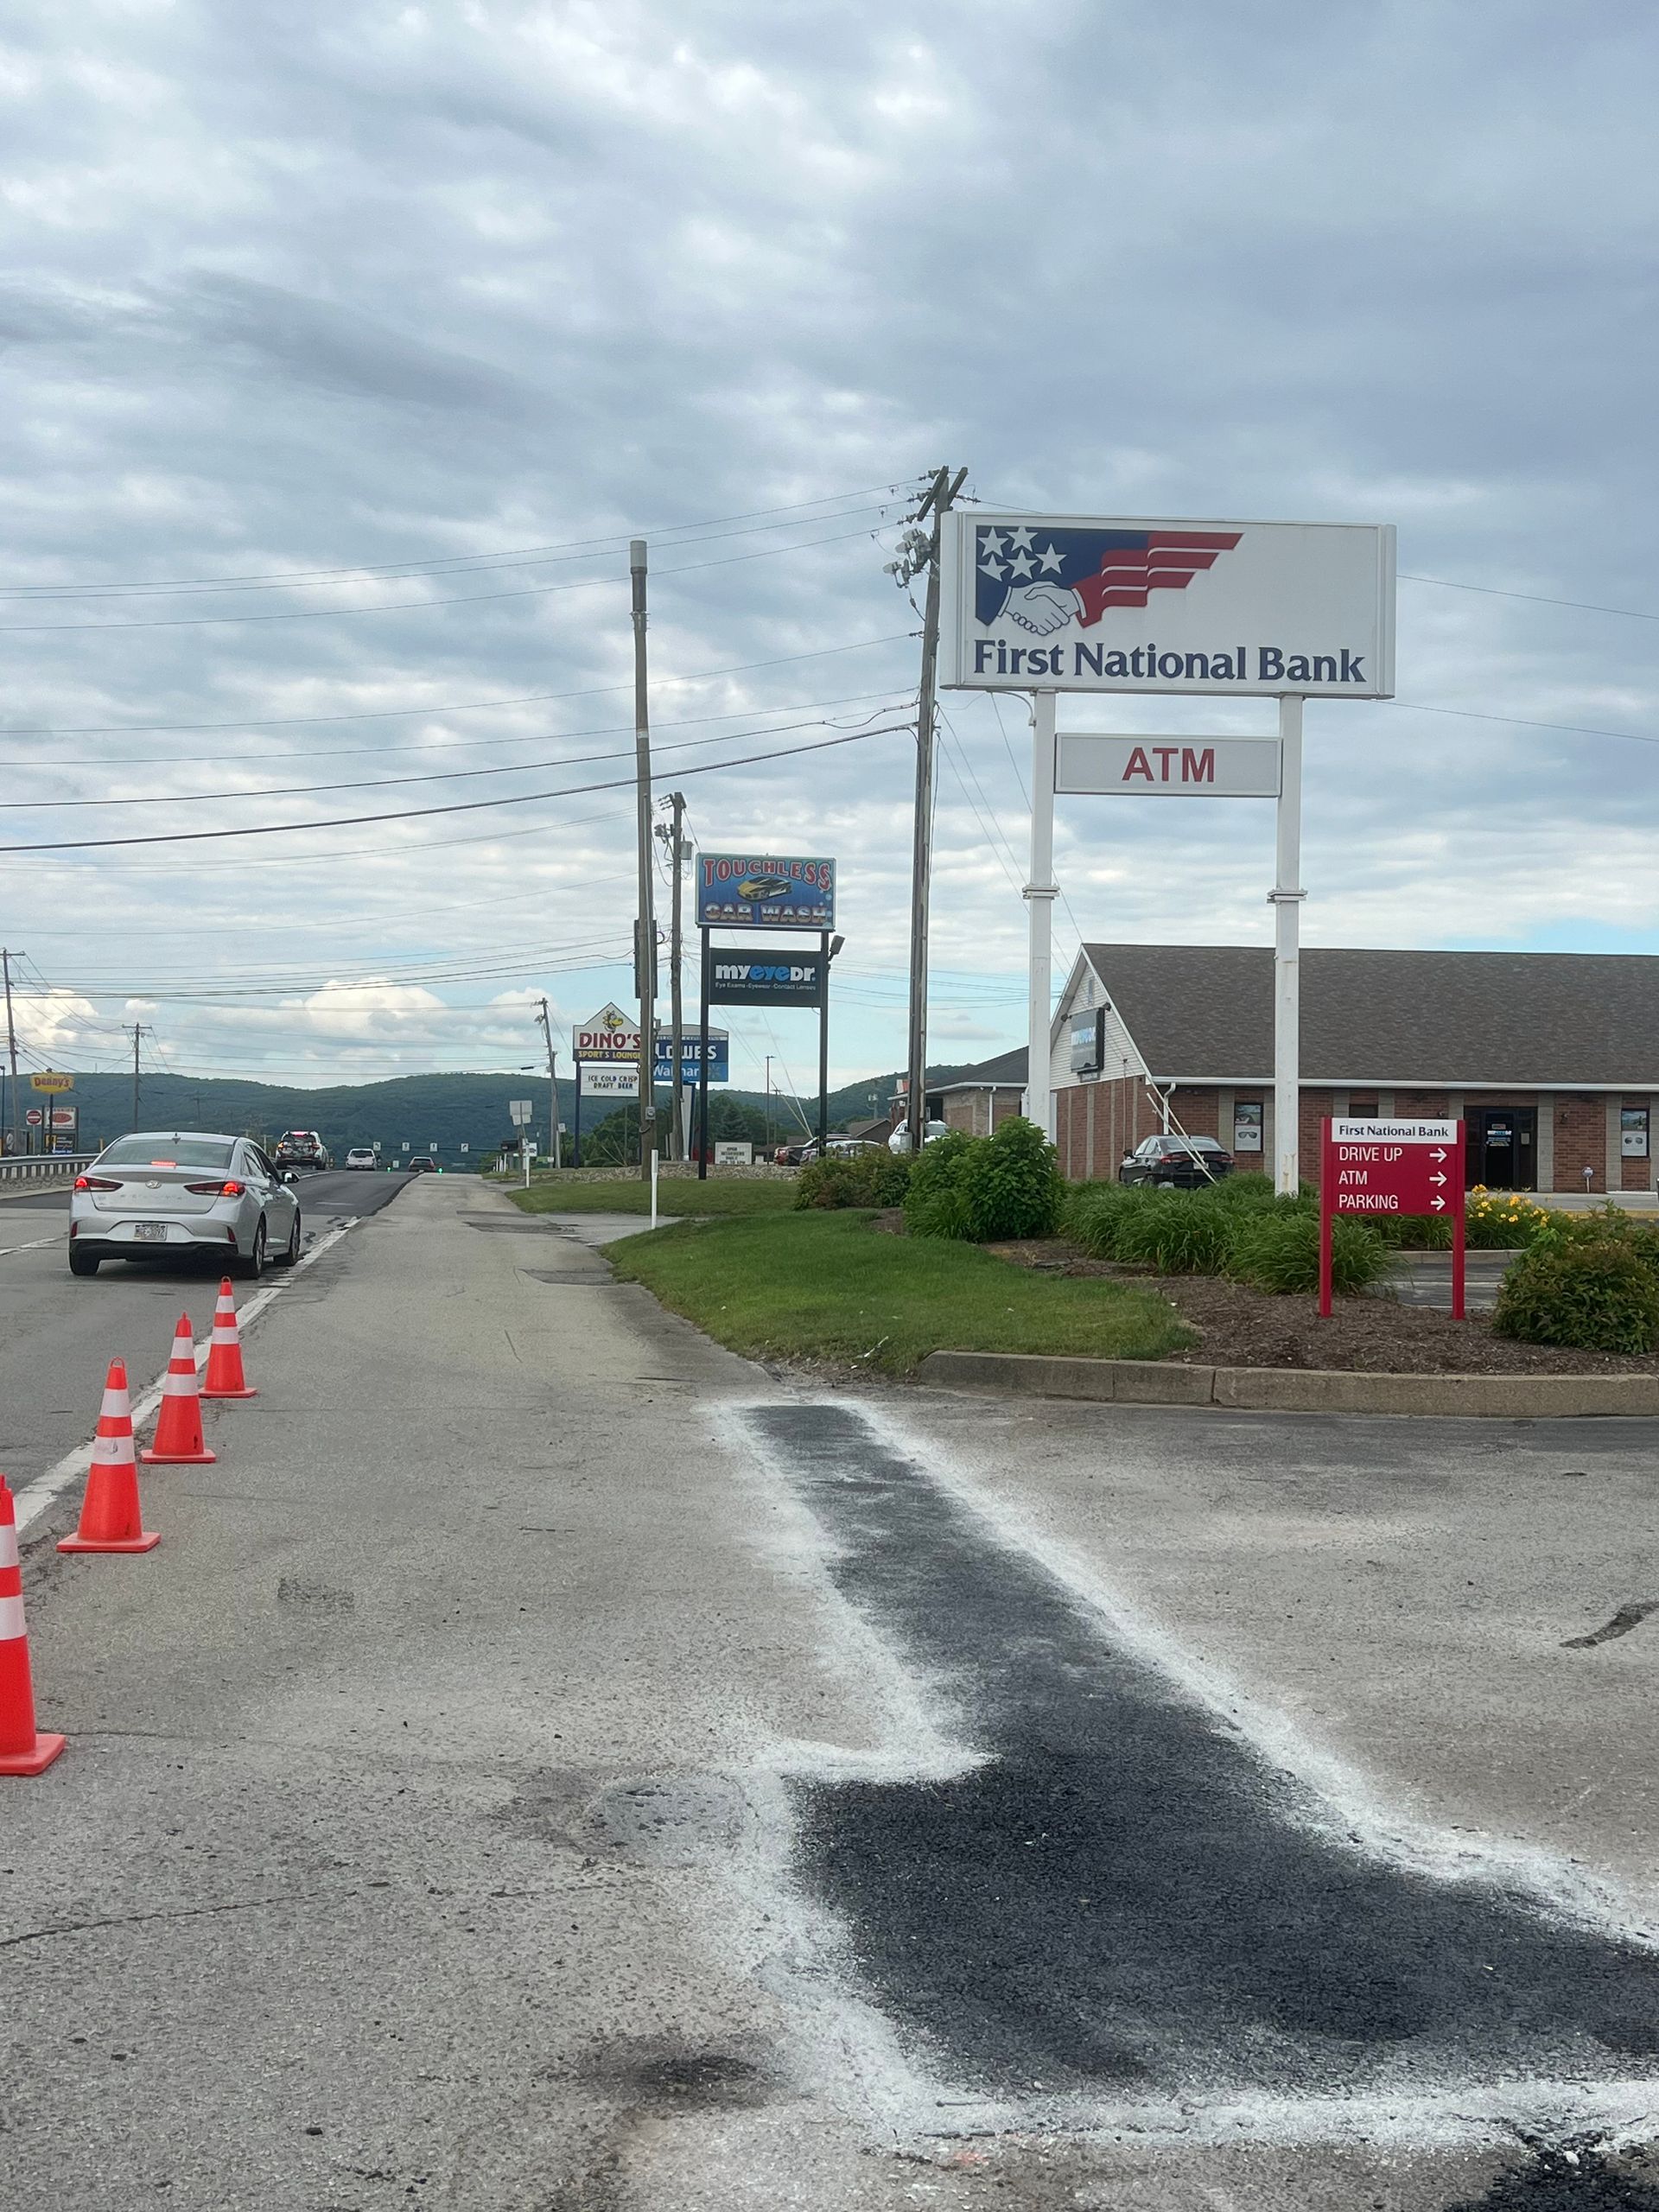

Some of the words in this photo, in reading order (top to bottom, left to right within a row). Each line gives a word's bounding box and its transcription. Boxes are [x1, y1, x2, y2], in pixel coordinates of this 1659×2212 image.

[974, 639, 1064, 676] First
[1074, 643, 1247, 680] National
[1258, 646, 1367, 683] Bank
[1122, 747, 1215, 783] ATM
[703, 858, 831, 891] TOUCHLESS
[704, 903, 753, 921] CAR
[760, 905, 828, 924] WASH
[579, 1033, 641, 1049] DINO'S
[35, 1077, 70, 1088] Denny's
[1339, 1125, 1364, 1136] First
[1367, 1126, 1415, 1137] National
[1418, 1127, 1449, 1137] Bank
[1339, 1147, 1380, 1161] DRIVE
[1384, 1147, 1403, 1162] UP
[1338, 1171, 1368, 1185] ATM
[1339, 1194, 1399, 1210] PARKING
